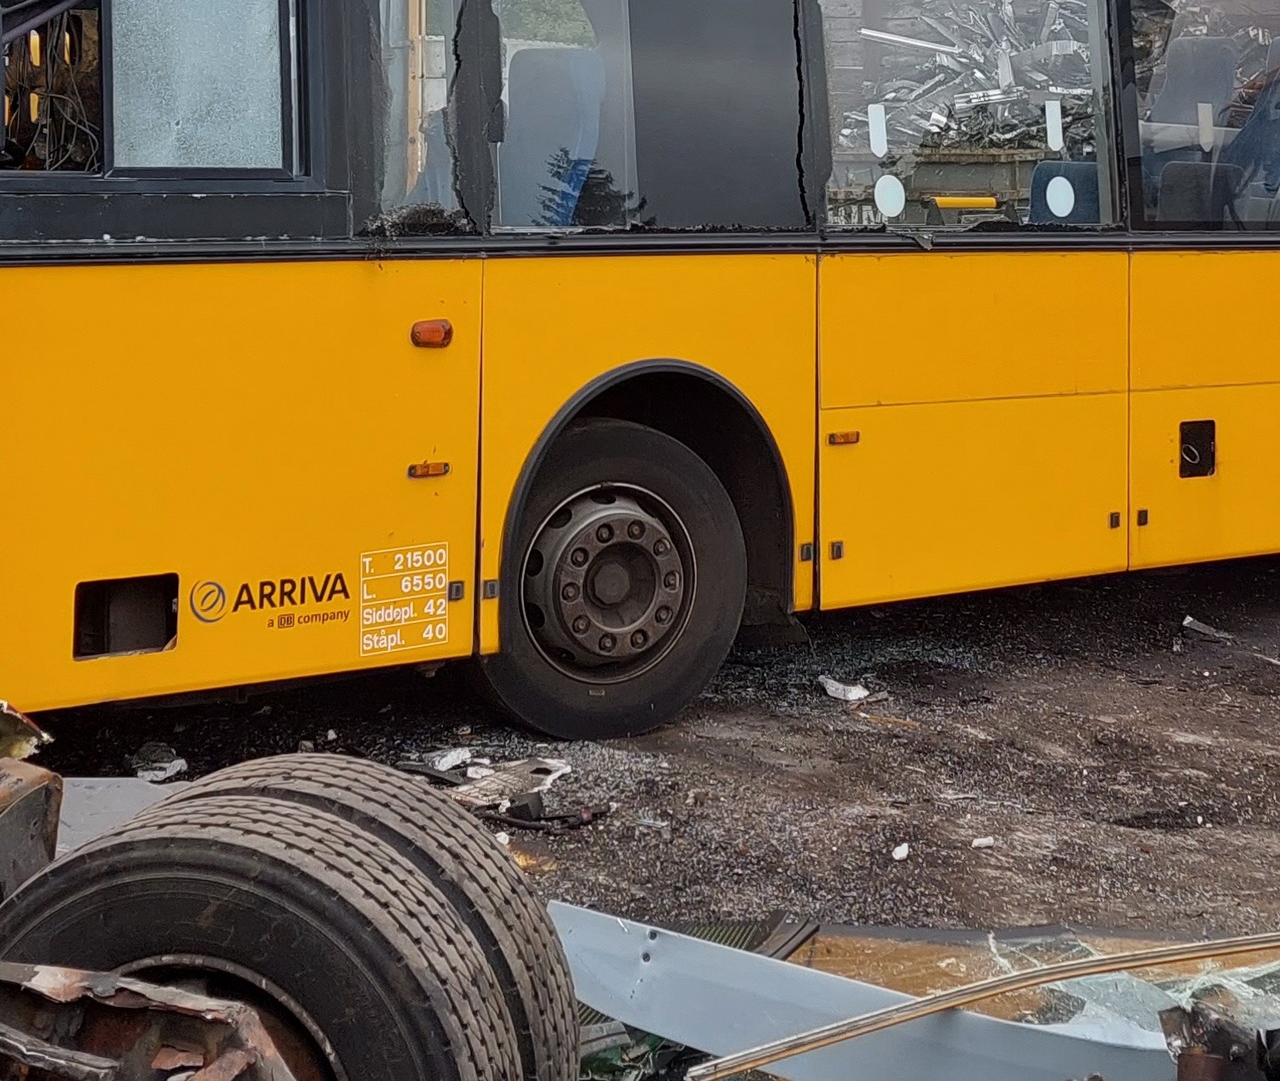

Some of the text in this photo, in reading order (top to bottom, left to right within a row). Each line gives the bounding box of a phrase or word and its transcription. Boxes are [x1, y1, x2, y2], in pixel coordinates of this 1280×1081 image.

[362, 548, 446, 574] T. 21500
[231, 572, 351, 613] ARRIVA
[363, 572, 446, 600] L. 6550
[267, 609, 351, 629] a DB company
[423, 598, 446, 616] 42
[362, 622, 446, 652] Ståpl. 40
